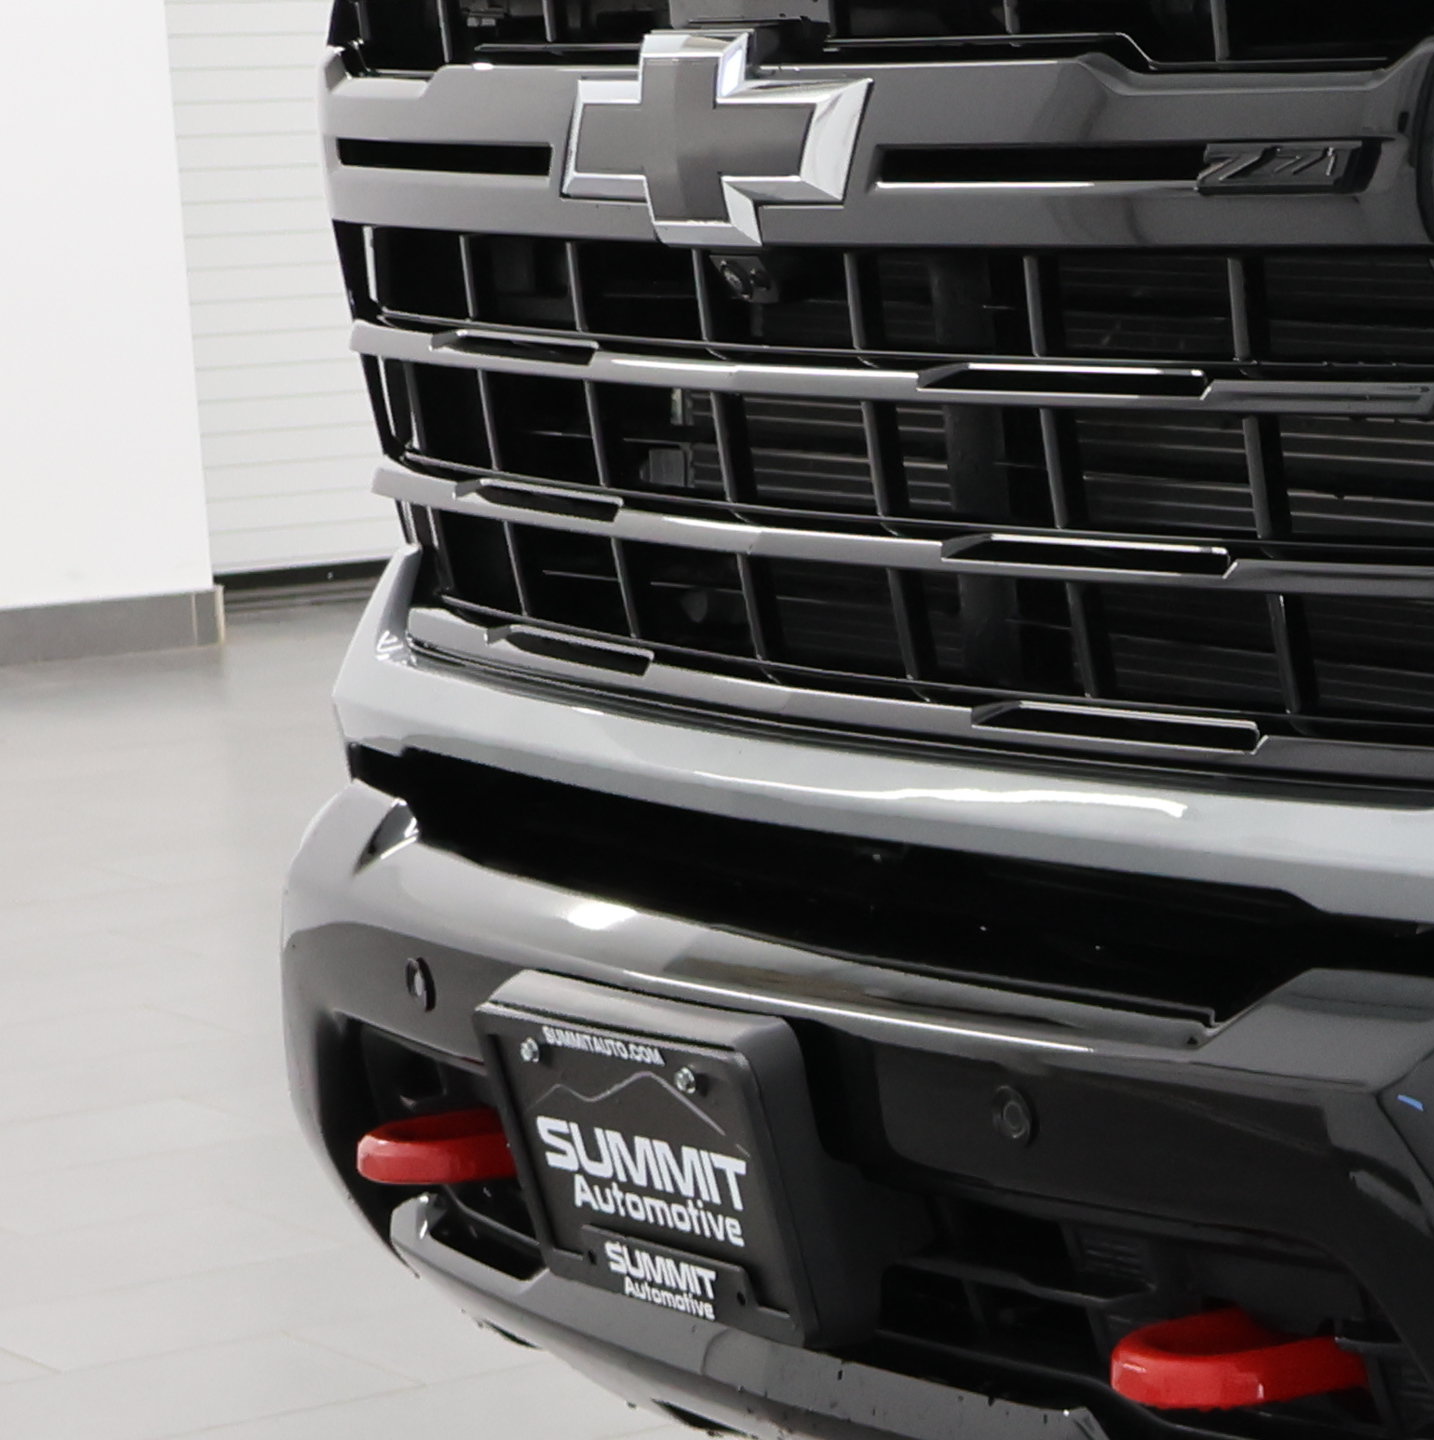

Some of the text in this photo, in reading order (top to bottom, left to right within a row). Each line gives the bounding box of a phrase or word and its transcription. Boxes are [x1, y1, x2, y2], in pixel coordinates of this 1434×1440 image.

[541, 1025, 666, 1067] SUMMITAUTO.COM
[536, 1115, 748, 1212] SUMMIT
[573, 1172, 746, 1249] Automotive
[604, 1240, 717, 1301] SUMMIT
[623, 1275, 716, 1322] Automotive
